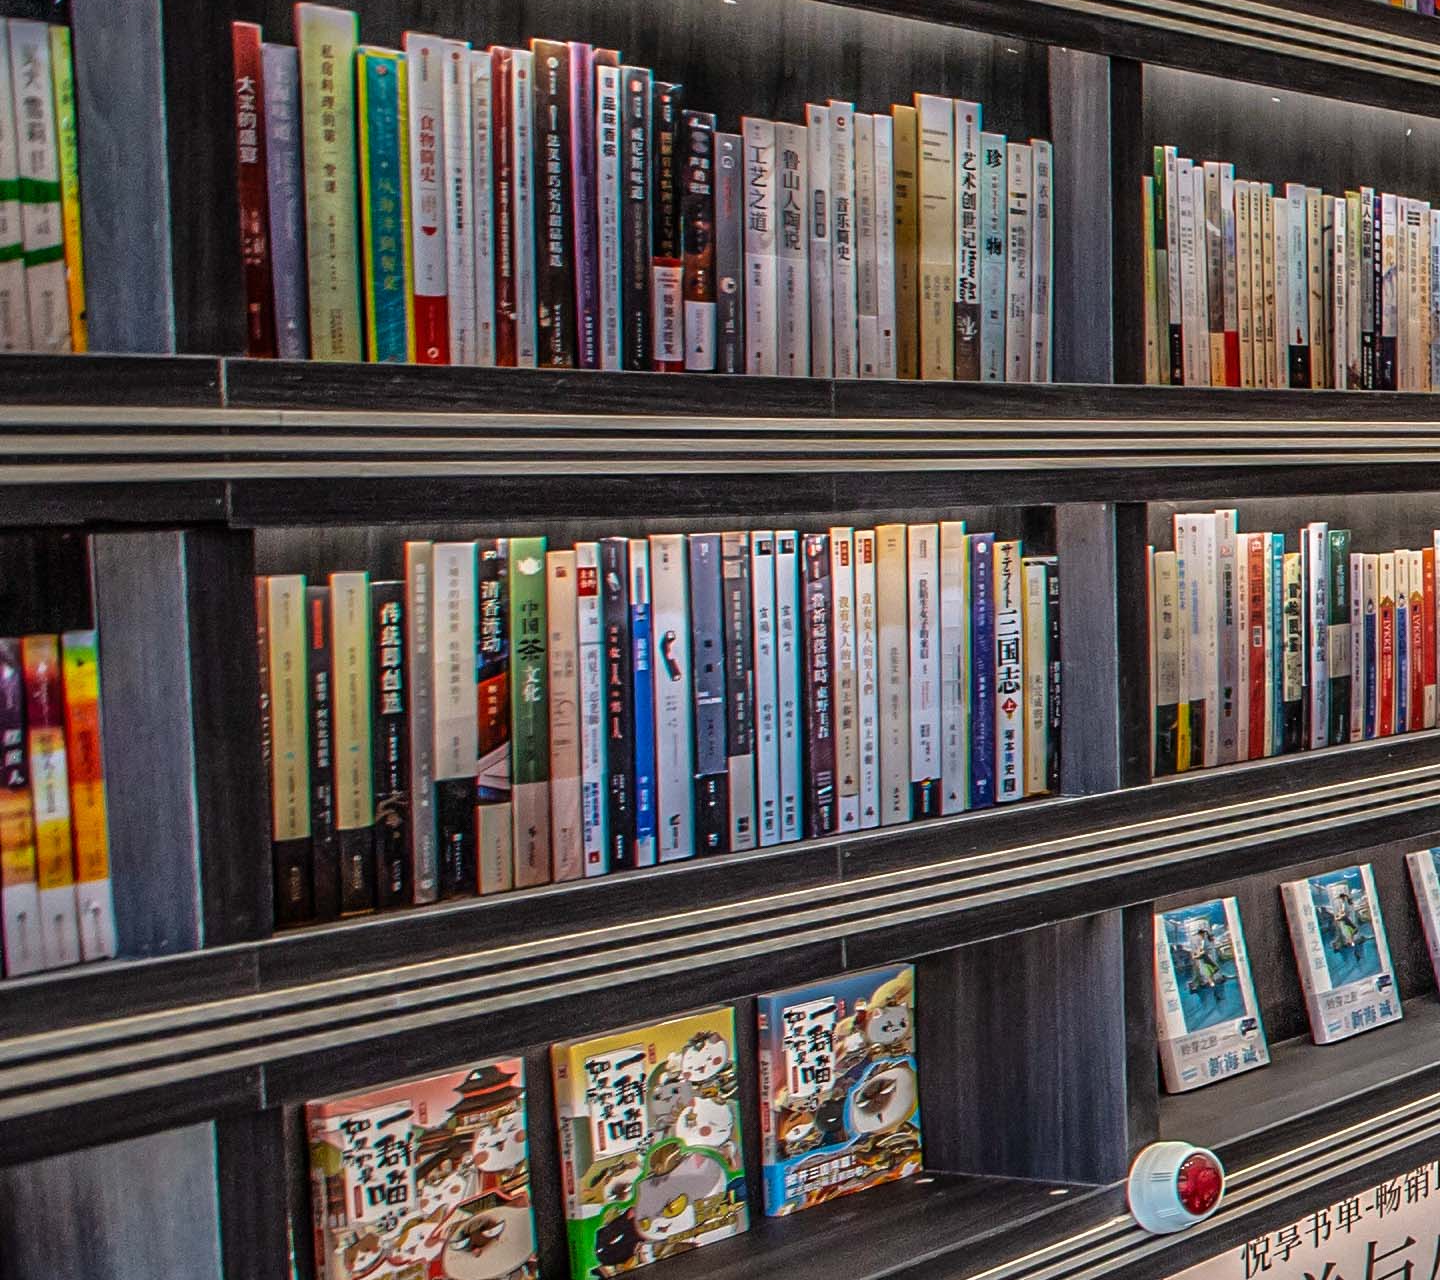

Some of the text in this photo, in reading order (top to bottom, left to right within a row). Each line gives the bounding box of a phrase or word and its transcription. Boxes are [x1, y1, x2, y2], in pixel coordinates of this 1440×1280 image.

[749, 145, 770, 233] 工艺之道
[517, 599, 547, 704] 中国茶文化
[998, 609, 1021, 696] 三国志
